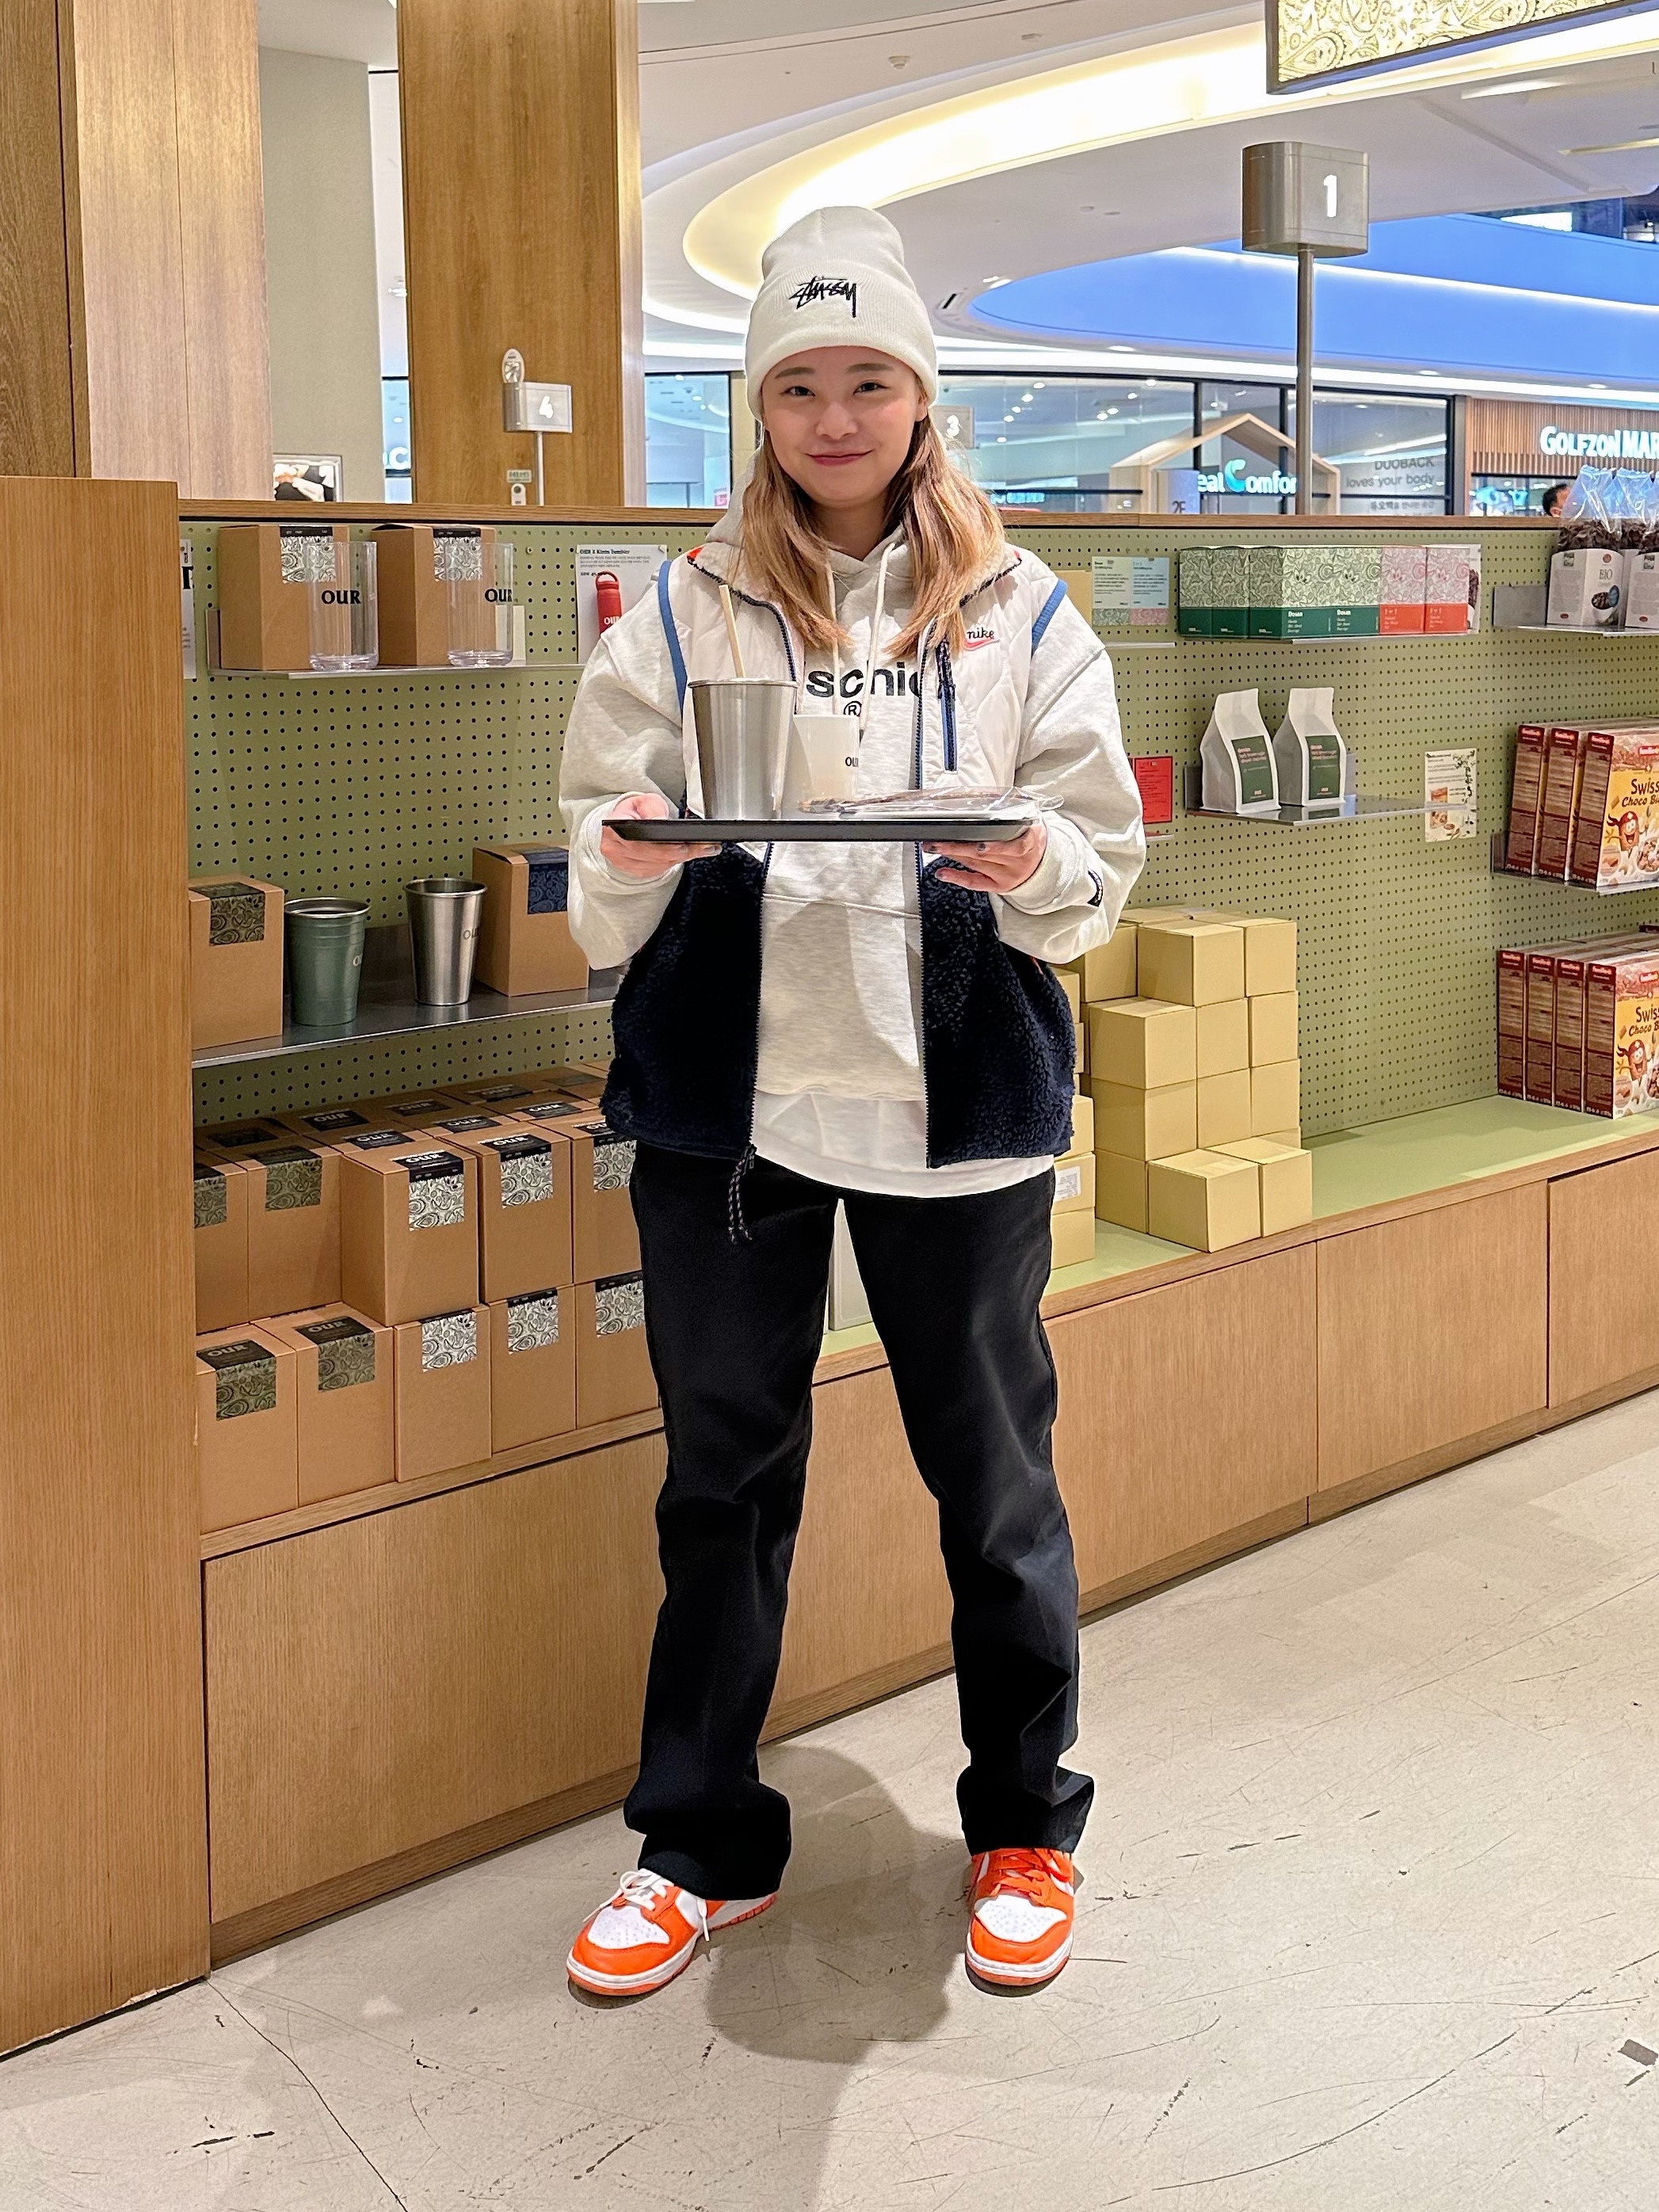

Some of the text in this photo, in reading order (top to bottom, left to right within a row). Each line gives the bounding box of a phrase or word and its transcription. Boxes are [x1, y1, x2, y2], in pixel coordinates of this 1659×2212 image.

[1323, 174, 1337, 218] 1
[539, 395, 553, 419] 4
[947, 415, 959, 437] 3
[1622, 429, 1659, 459] MAR
[1375, 457, 1435, 471] DUOBACK
[1197, 459, 1297, 494] eal Comfor
[1347, 473, 1434, 487] loves your body
[321, 589, 361, 604] OUR
[967, 627, 995, 640] nike
[314, 1112, 349, 1123] OUR
[446, 1116, 483, 1126] OUR
[357, 1131, 394, 1142] OUR
[493, 1135, 530, 1146] OUR
[406, 1152, 444, 1163] OUR
[308, 1320, 347, 1333] OUR
[207, 1344, 247, 1357] OUR
